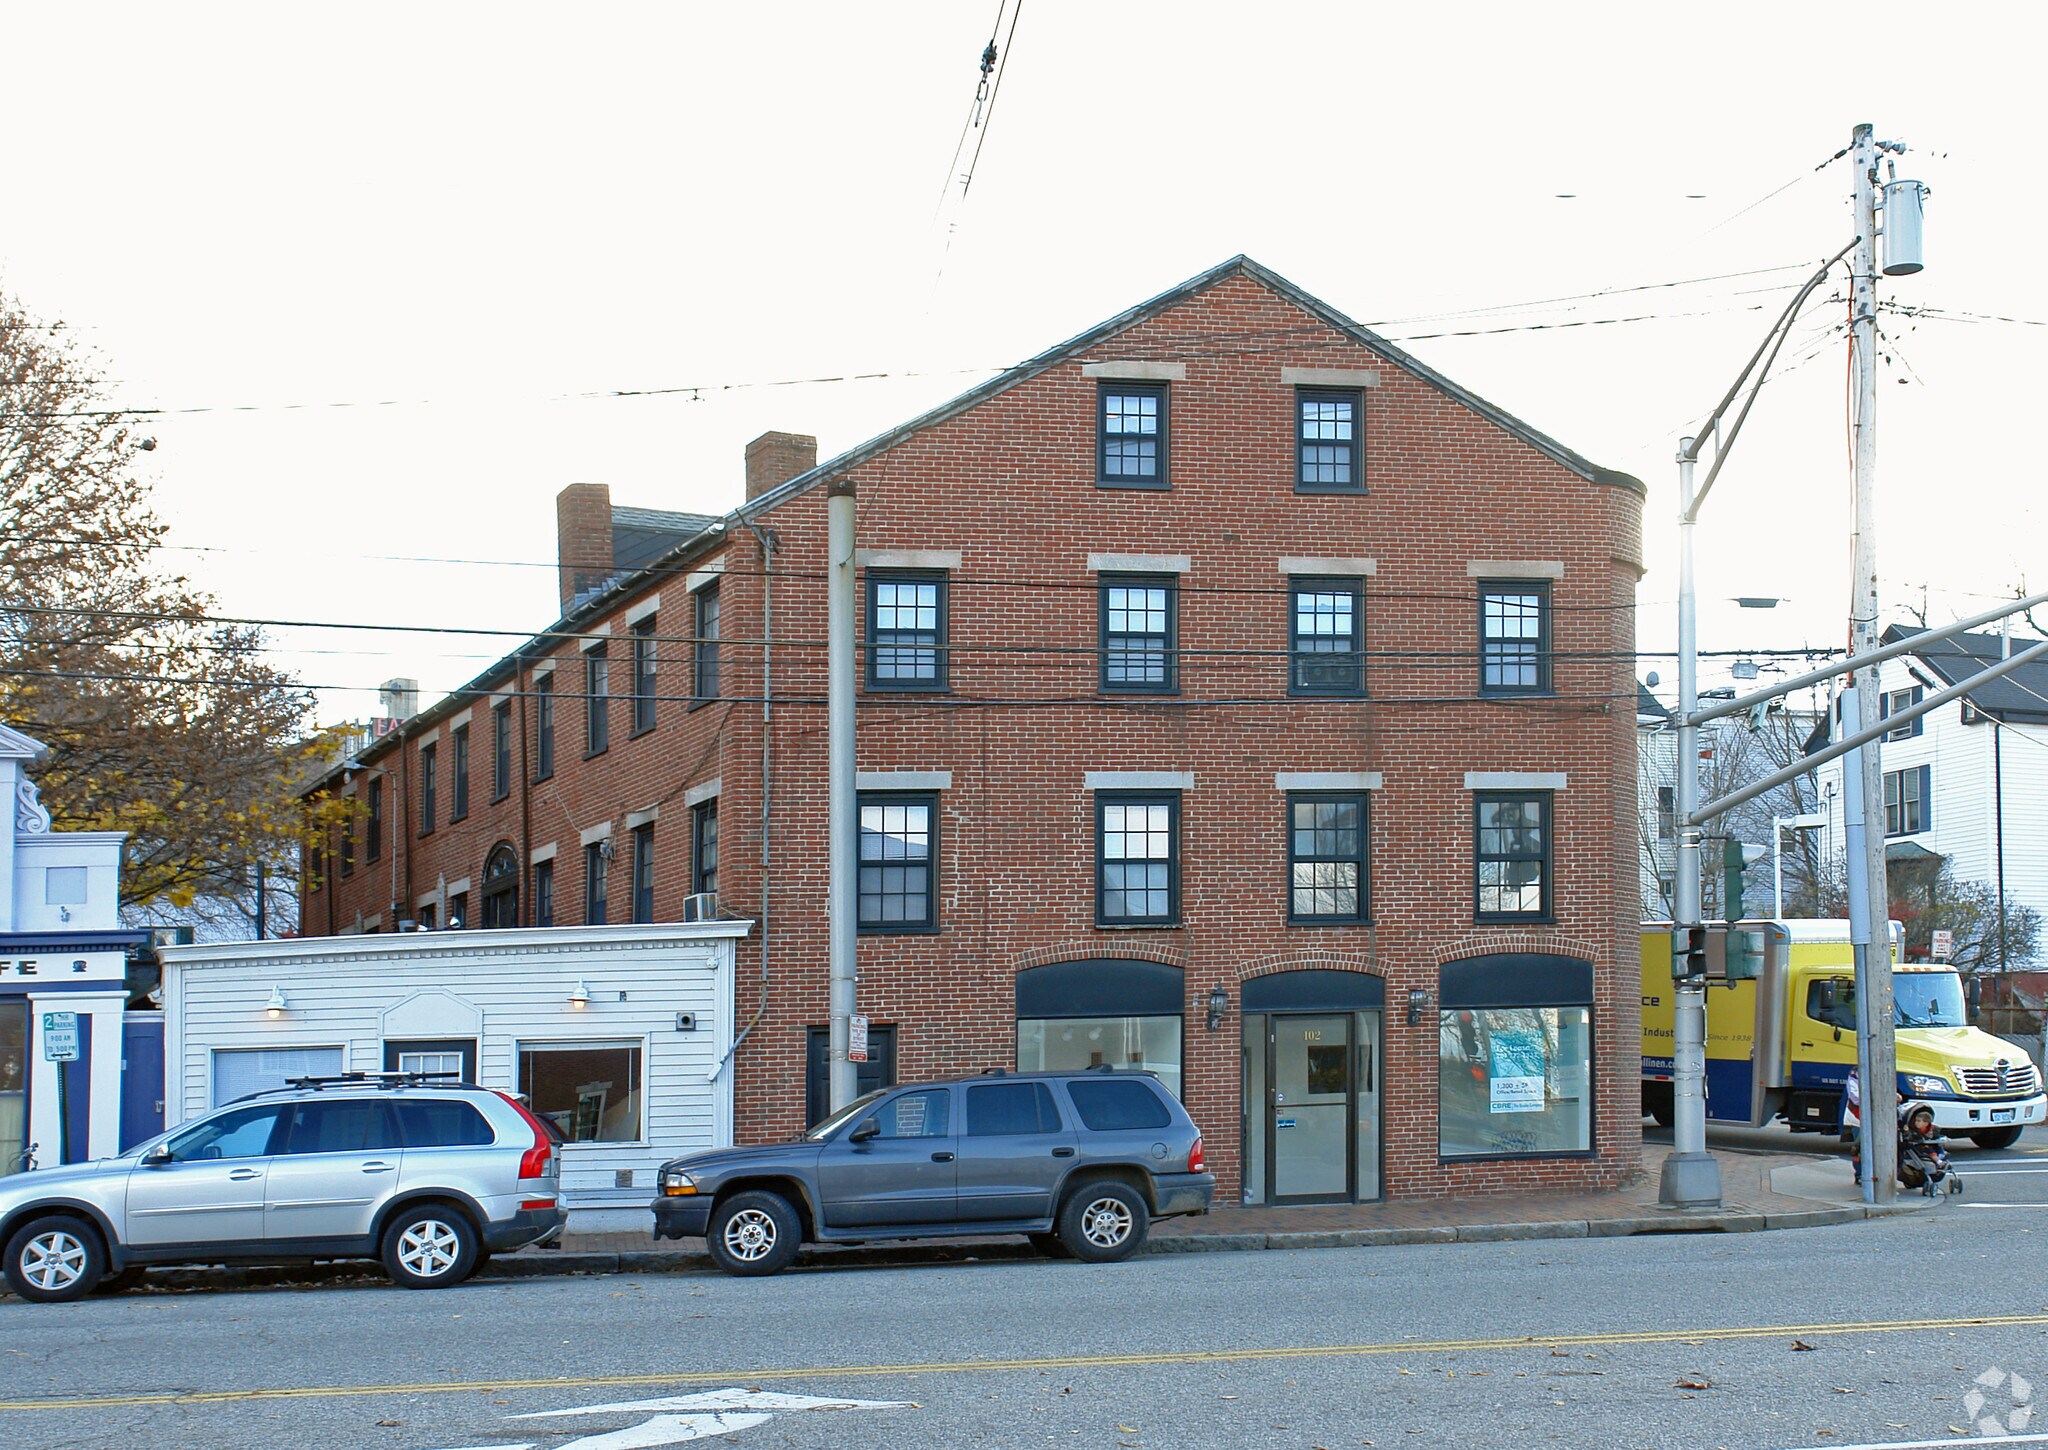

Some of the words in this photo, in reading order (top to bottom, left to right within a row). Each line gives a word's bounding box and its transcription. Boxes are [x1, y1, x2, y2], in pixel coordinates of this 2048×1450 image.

[1641, 996, 1660, 1006] ce
[44, 1015, 52, 1028] 2
[1303, 1030, 1321, 1041] 102
[1643, 1027, 1674, 1038] Indust
[1706, 1033, 1728, 1041] Since
[1731, 1034, 1752, 1042] 1938
